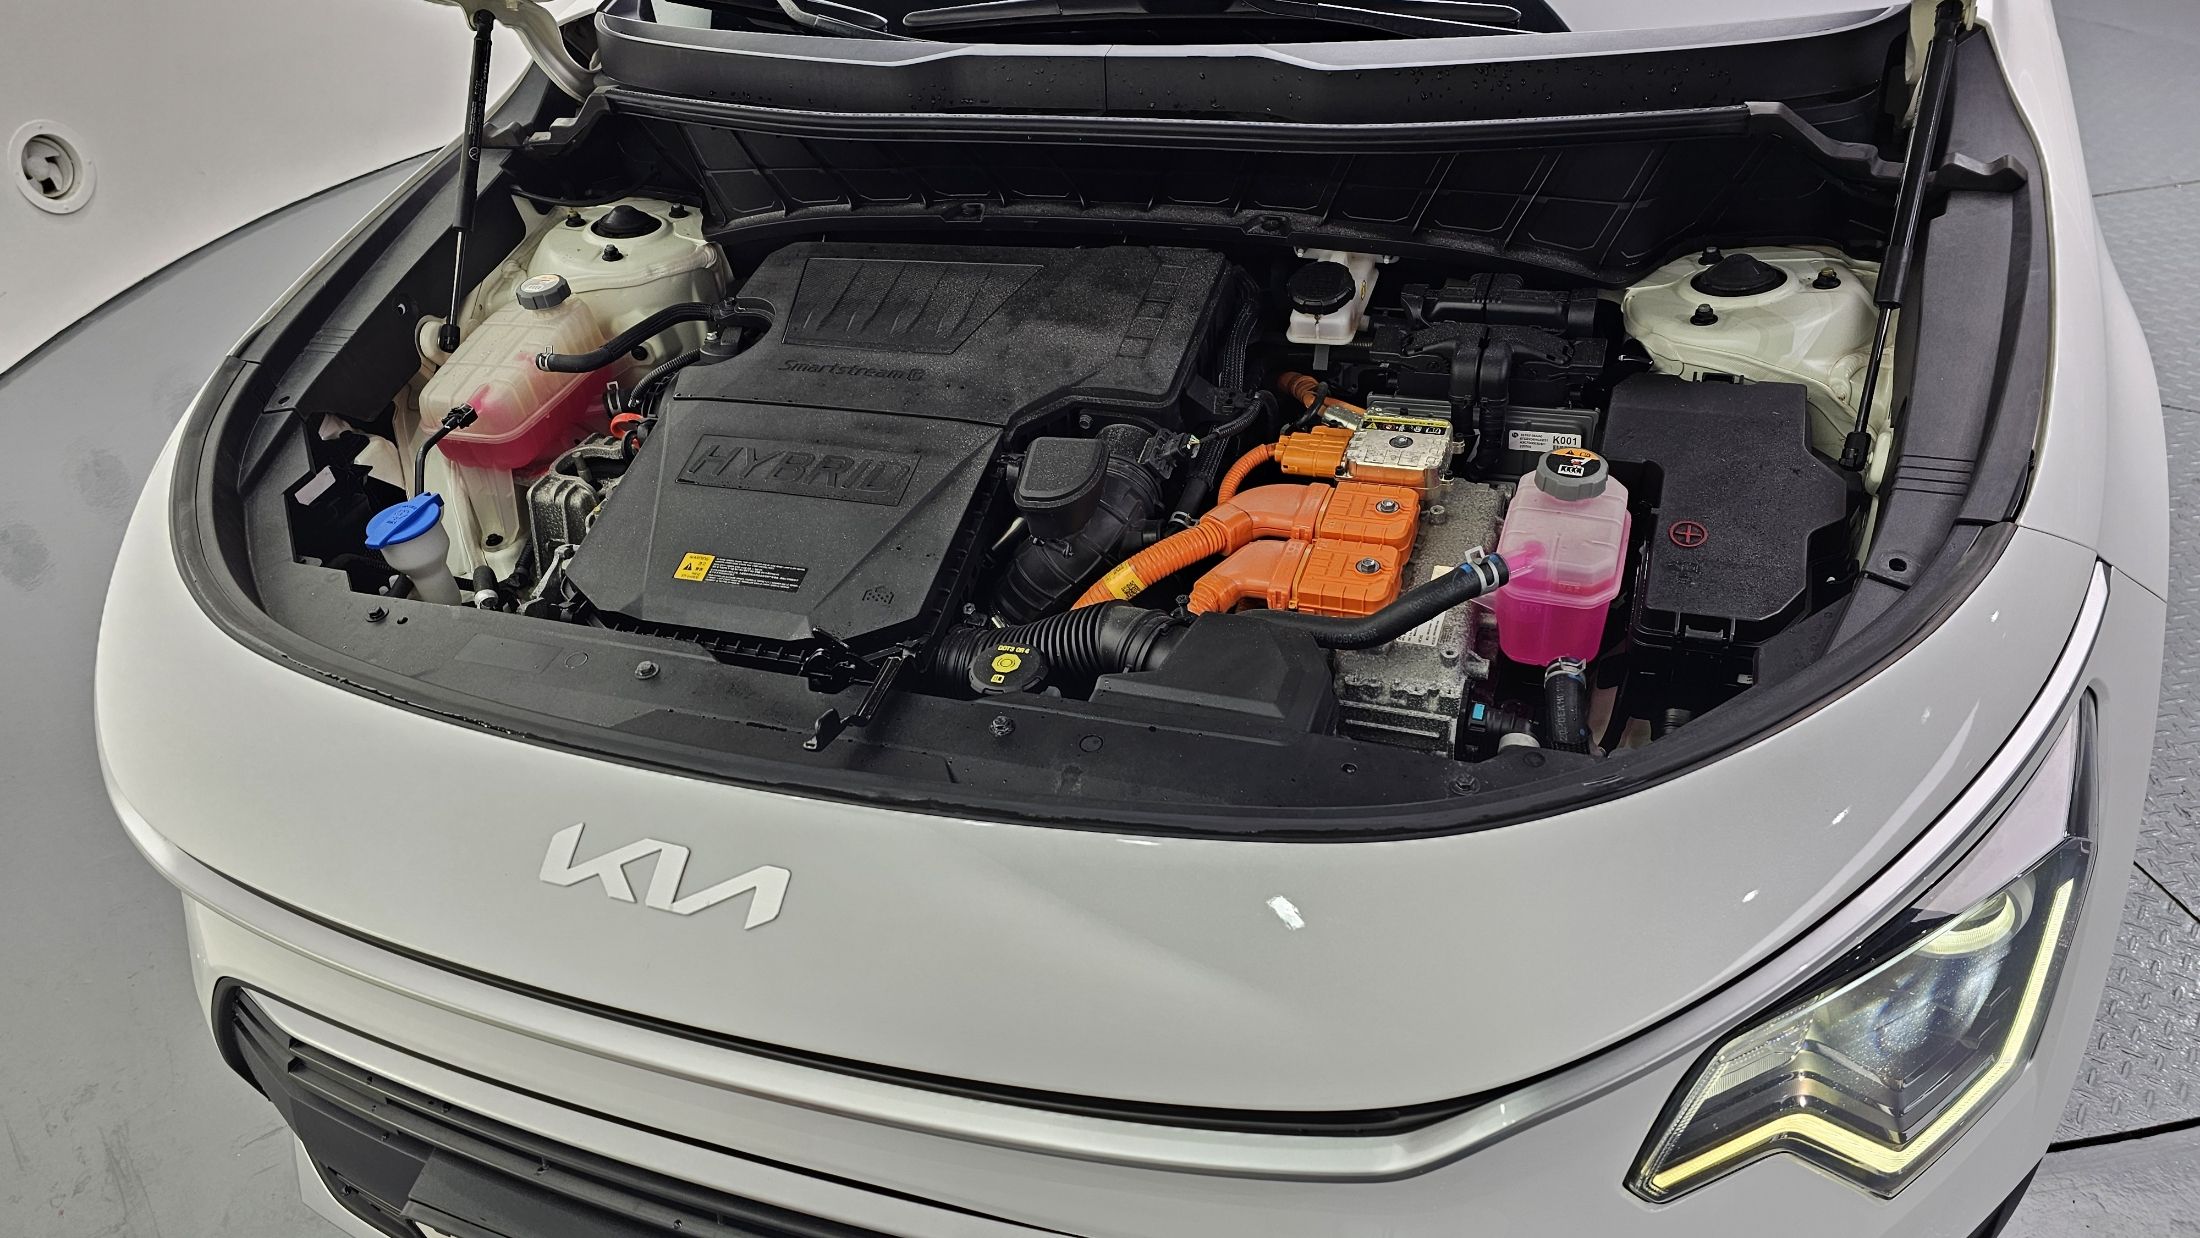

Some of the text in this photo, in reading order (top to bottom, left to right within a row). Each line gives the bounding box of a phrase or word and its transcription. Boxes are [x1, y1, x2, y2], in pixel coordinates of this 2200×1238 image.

[778, 360, 903, 379] Smartstream
[1552, 435, 1577, 446] K001
[688, 444, 911, 493] HYBRID
[539, 822, 791, 930] KIA
